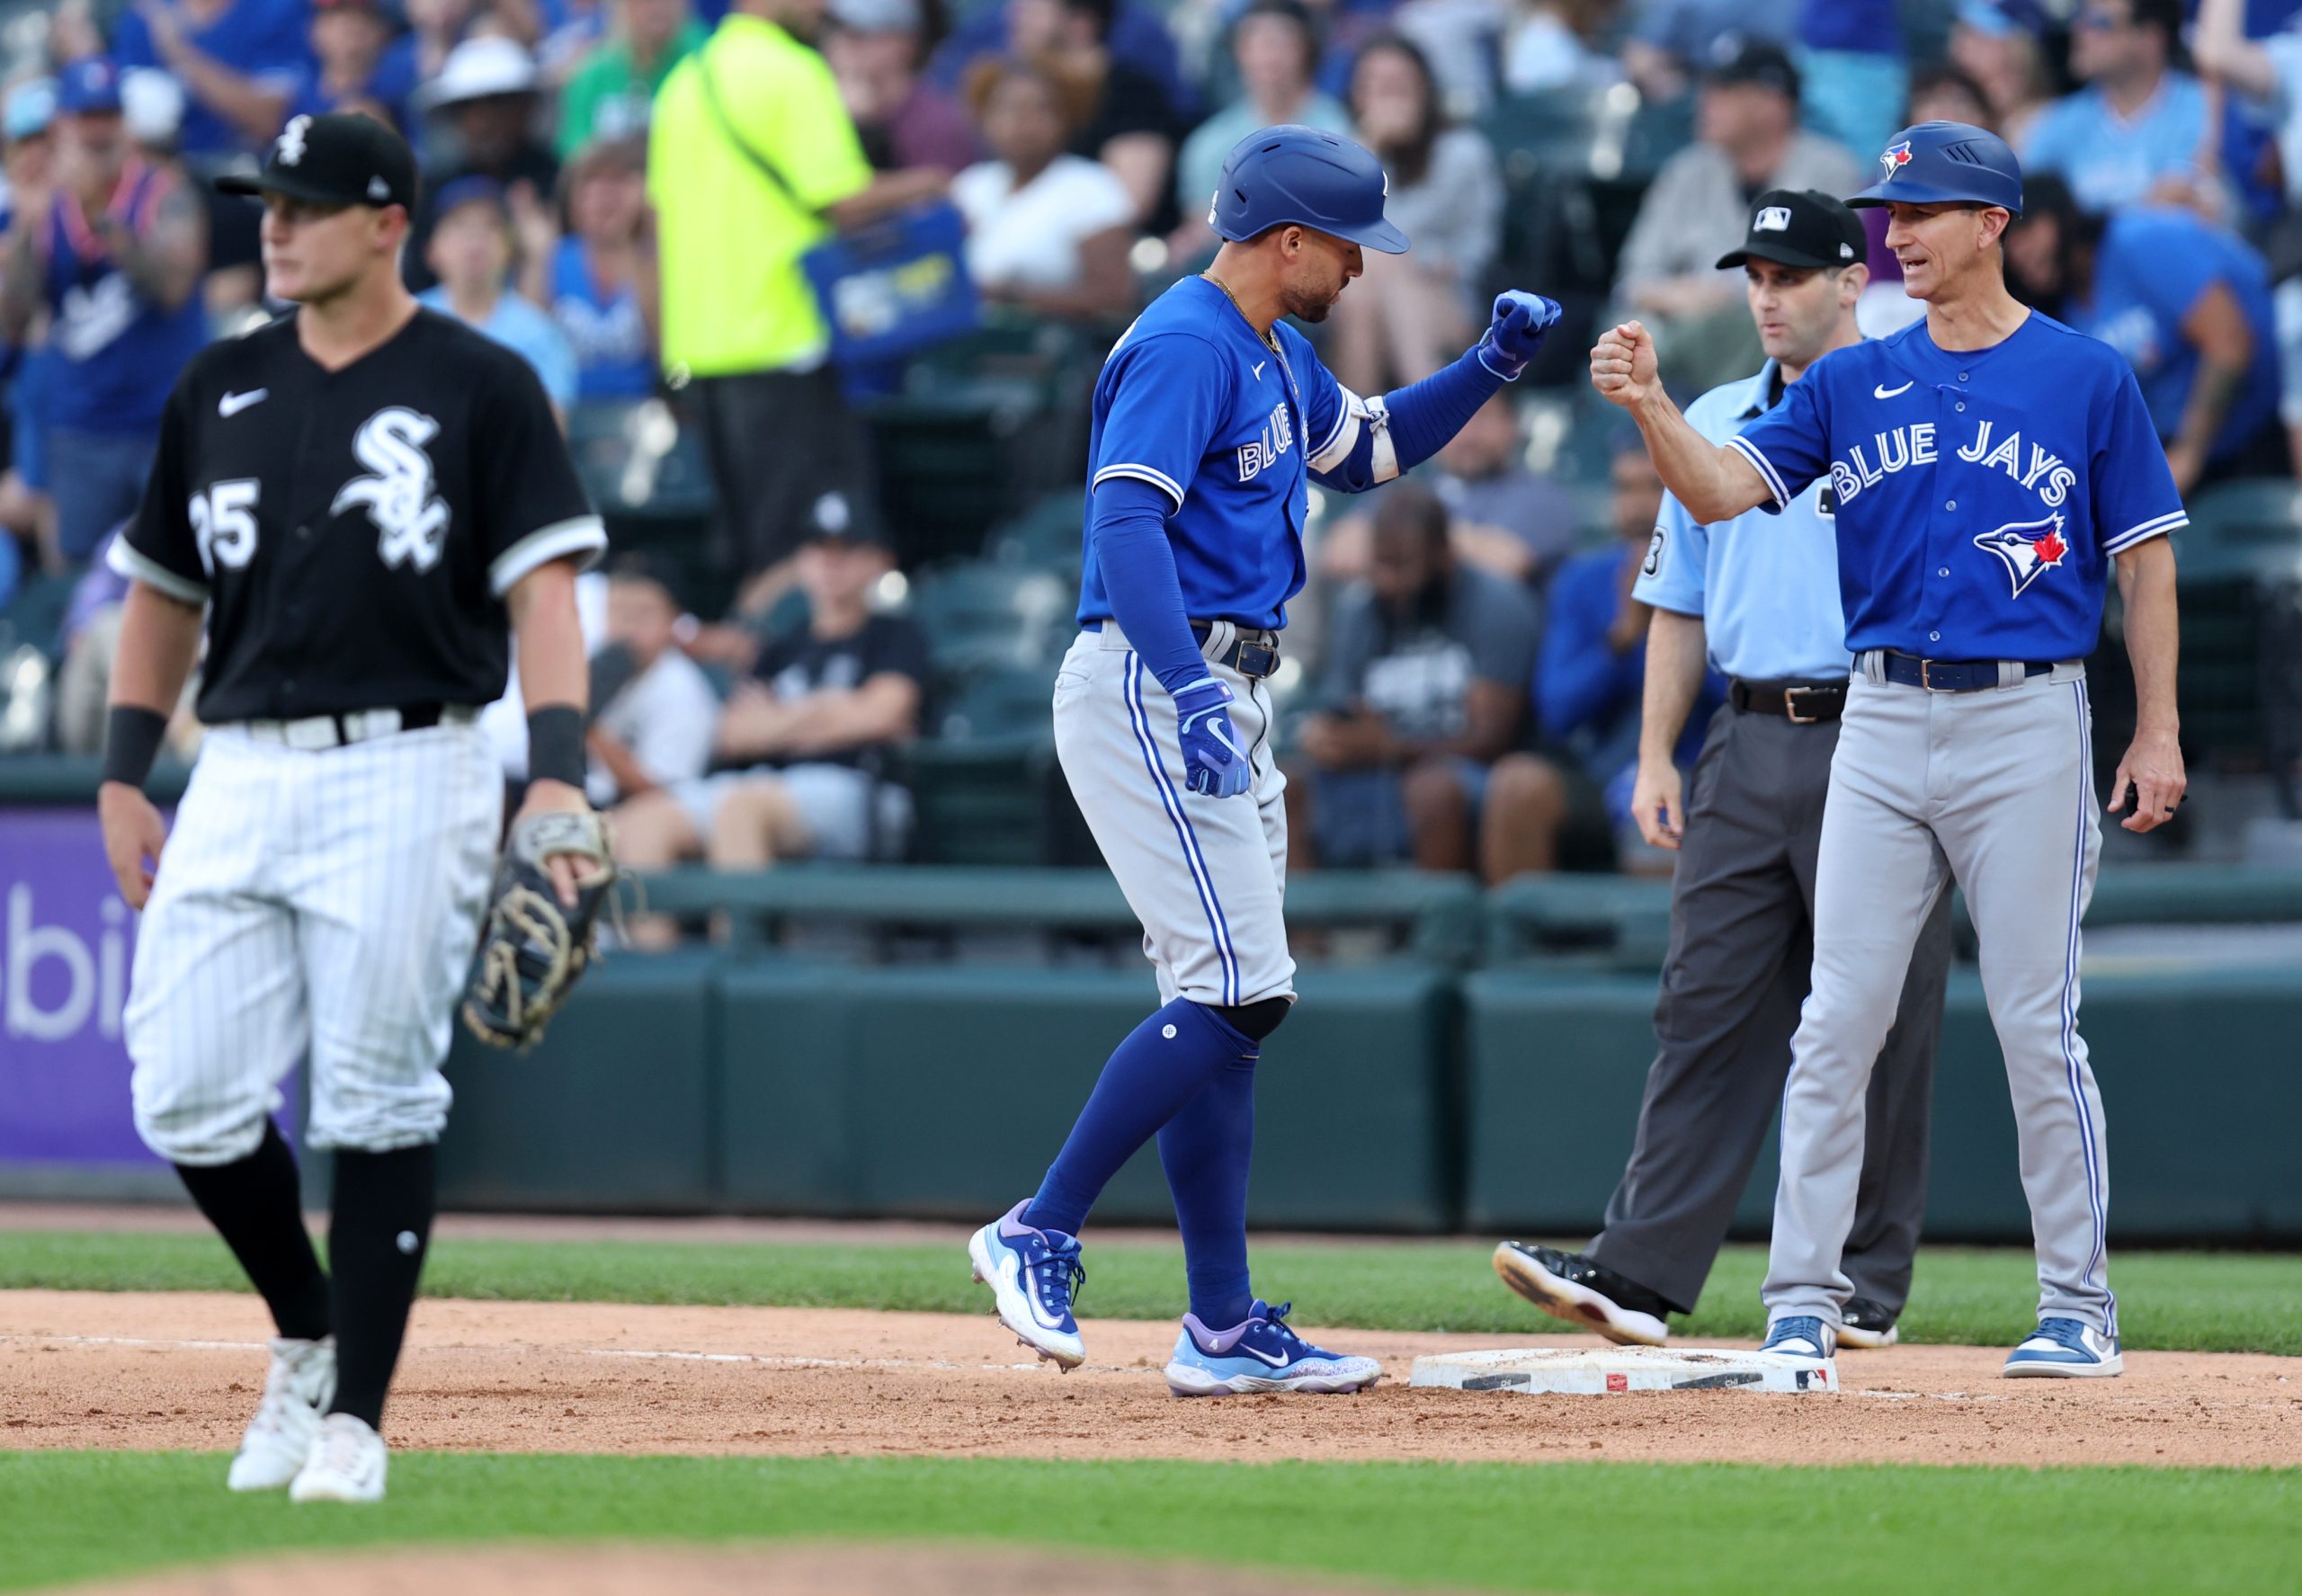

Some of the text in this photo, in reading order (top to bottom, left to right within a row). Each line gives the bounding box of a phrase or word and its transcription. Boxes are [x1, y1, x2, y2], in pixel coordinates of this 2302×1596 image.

[1237, 402, 1293, 482] BLUE
[1830, 420, 2076, 507] BLUE JAYS
[3, 879, 135, 1041] bi
